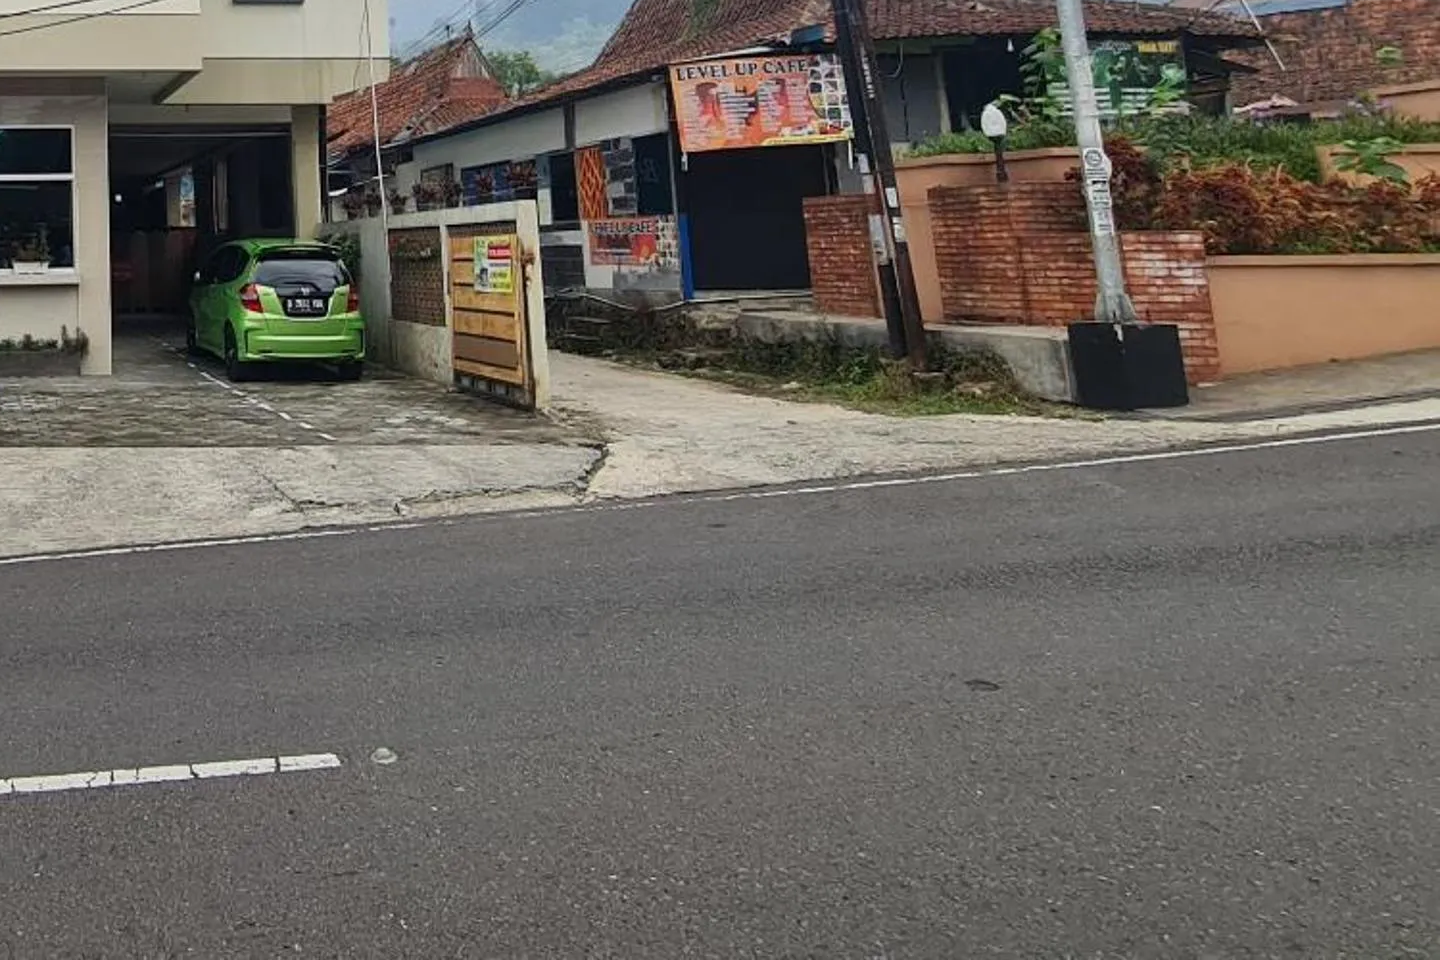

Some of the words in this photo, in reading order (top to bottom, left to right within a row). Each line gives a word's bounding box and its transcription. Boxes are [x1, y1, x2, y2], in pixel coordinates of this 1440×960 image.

[676, 65, 731, 81] LEVEL
[734, 62, 758, 76] UP
[763, 59, 809, 74] CAFE
